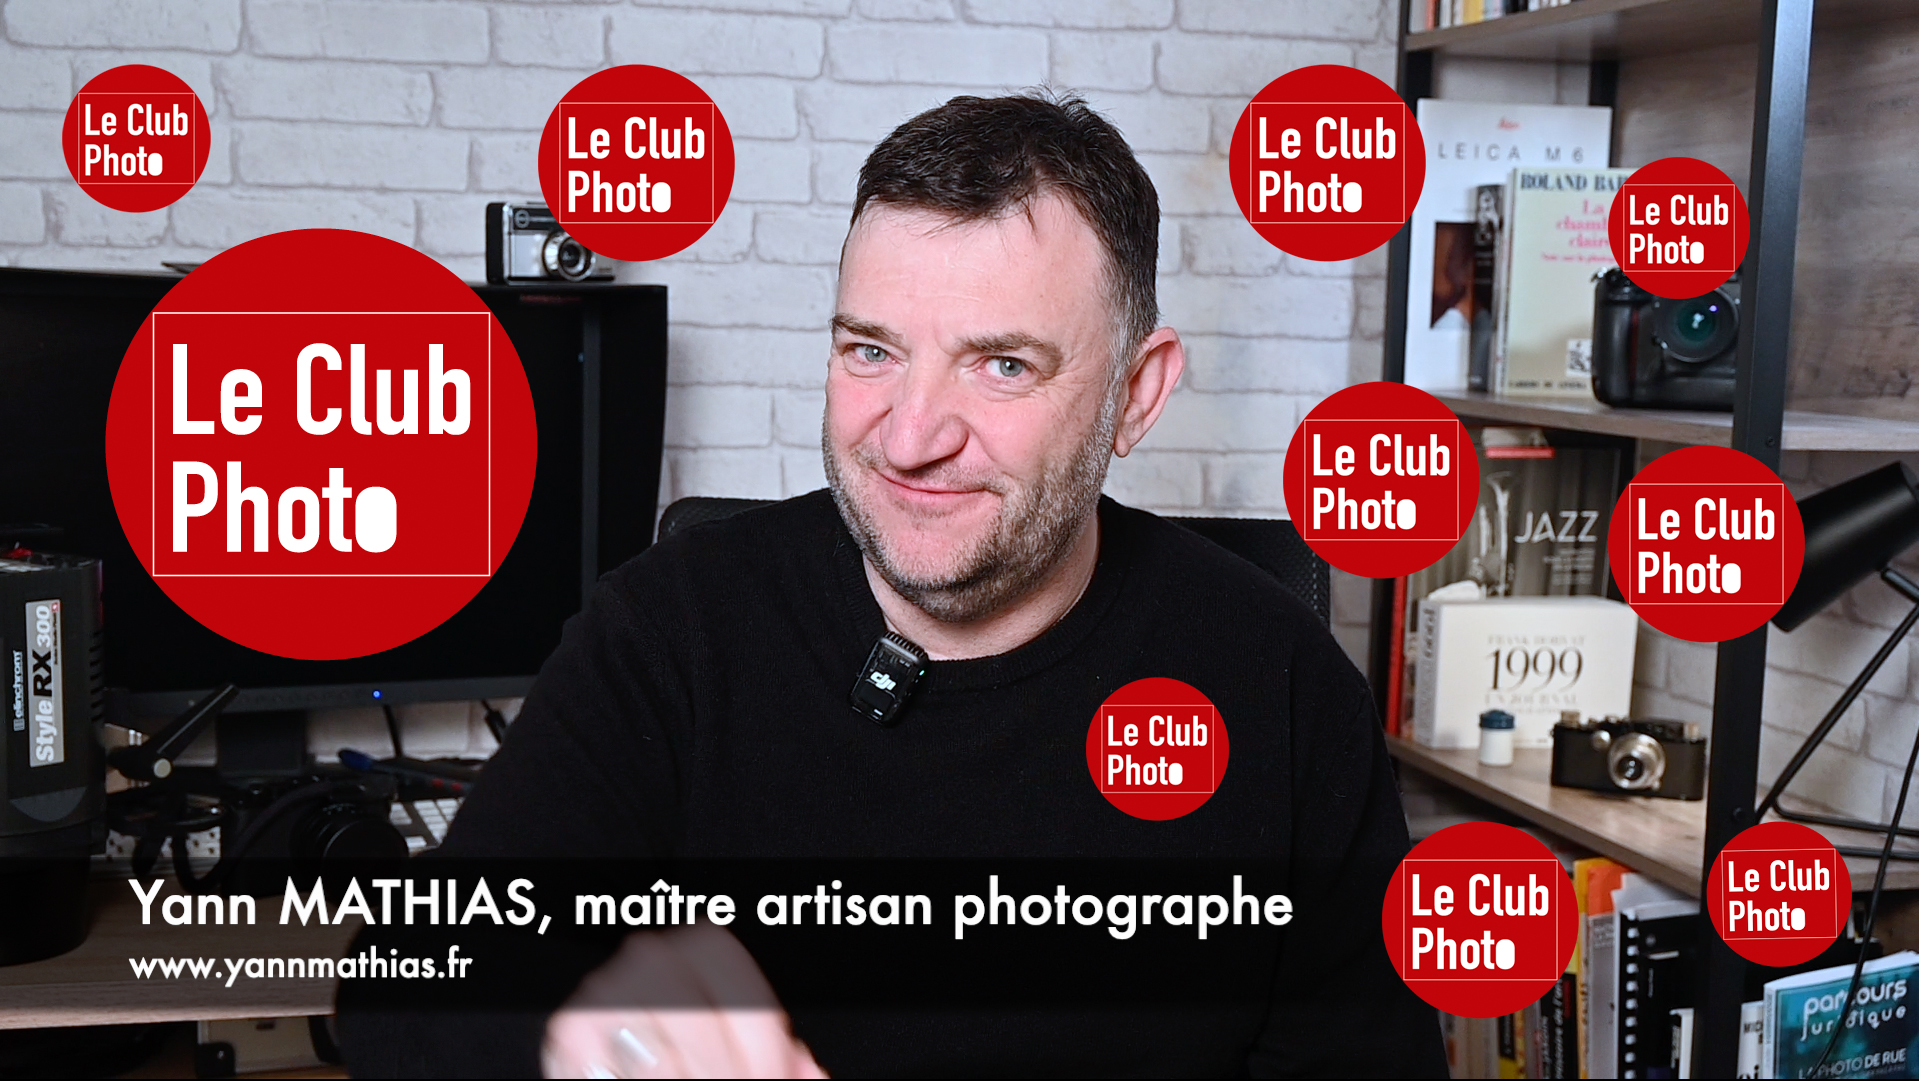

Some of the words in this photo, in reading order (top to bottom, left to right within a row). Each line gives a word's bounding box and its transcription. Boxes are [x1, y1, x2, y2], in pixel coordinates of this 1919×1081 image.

[1437, 142, 1521, 162] LEICA
[1521, 172, 1588, 191] ROLAND
[1514, 510, 1599, 543] JAZZ
[36, 605, 51, 648] 300
[32, 649, 53, 697] RX
[1486, 645, 1584, 692] 1999
[35, 700, 57, 762] Style
[1802, 979, 1907, 1028] parours
[1801, 1006, 1906, 1041] jurdique
[1864, 1051, 1881, 1068] DE
[1881, 1047, 1907, 1065] RUE
